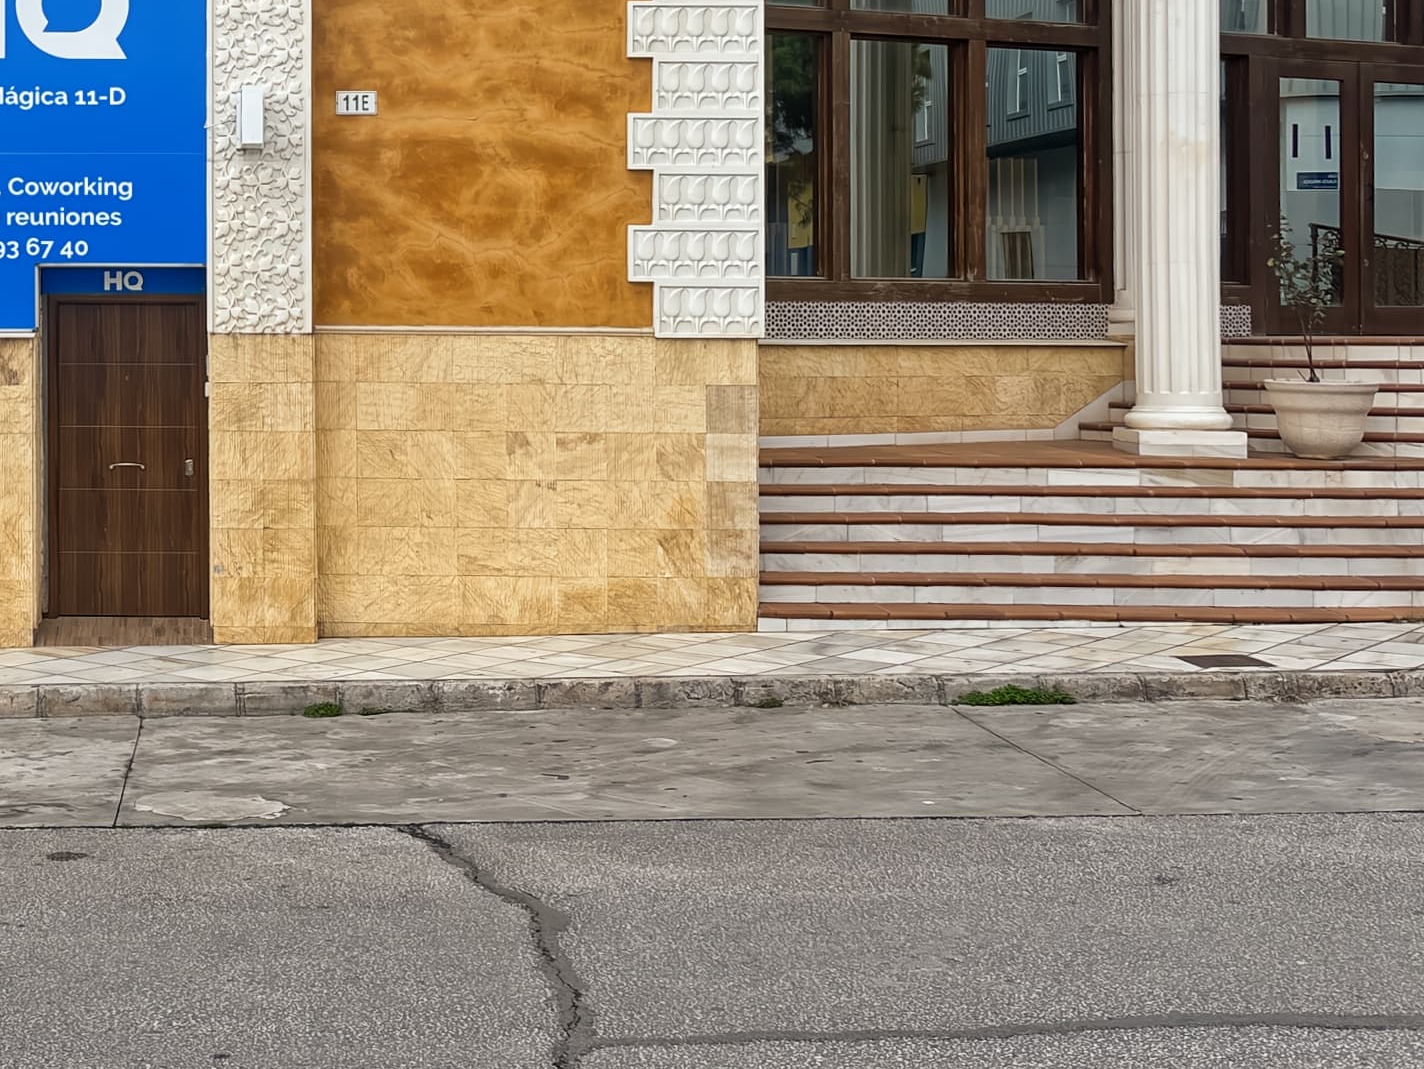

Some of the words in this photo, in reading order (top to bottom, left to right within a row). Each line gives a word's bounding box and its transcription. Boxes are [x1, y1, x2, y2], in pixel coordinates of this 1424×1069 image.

[74, 86, 127, 106] 11-D
[343, 94, 370, 111] 11E
[7, 176, 134, 202] Coworking
[6, 207, 123, 227] reuniones
[25, 237, 54, 260] 67
[60, 240, 89, 259] 40
[103, 270, 144, 292] HQ
